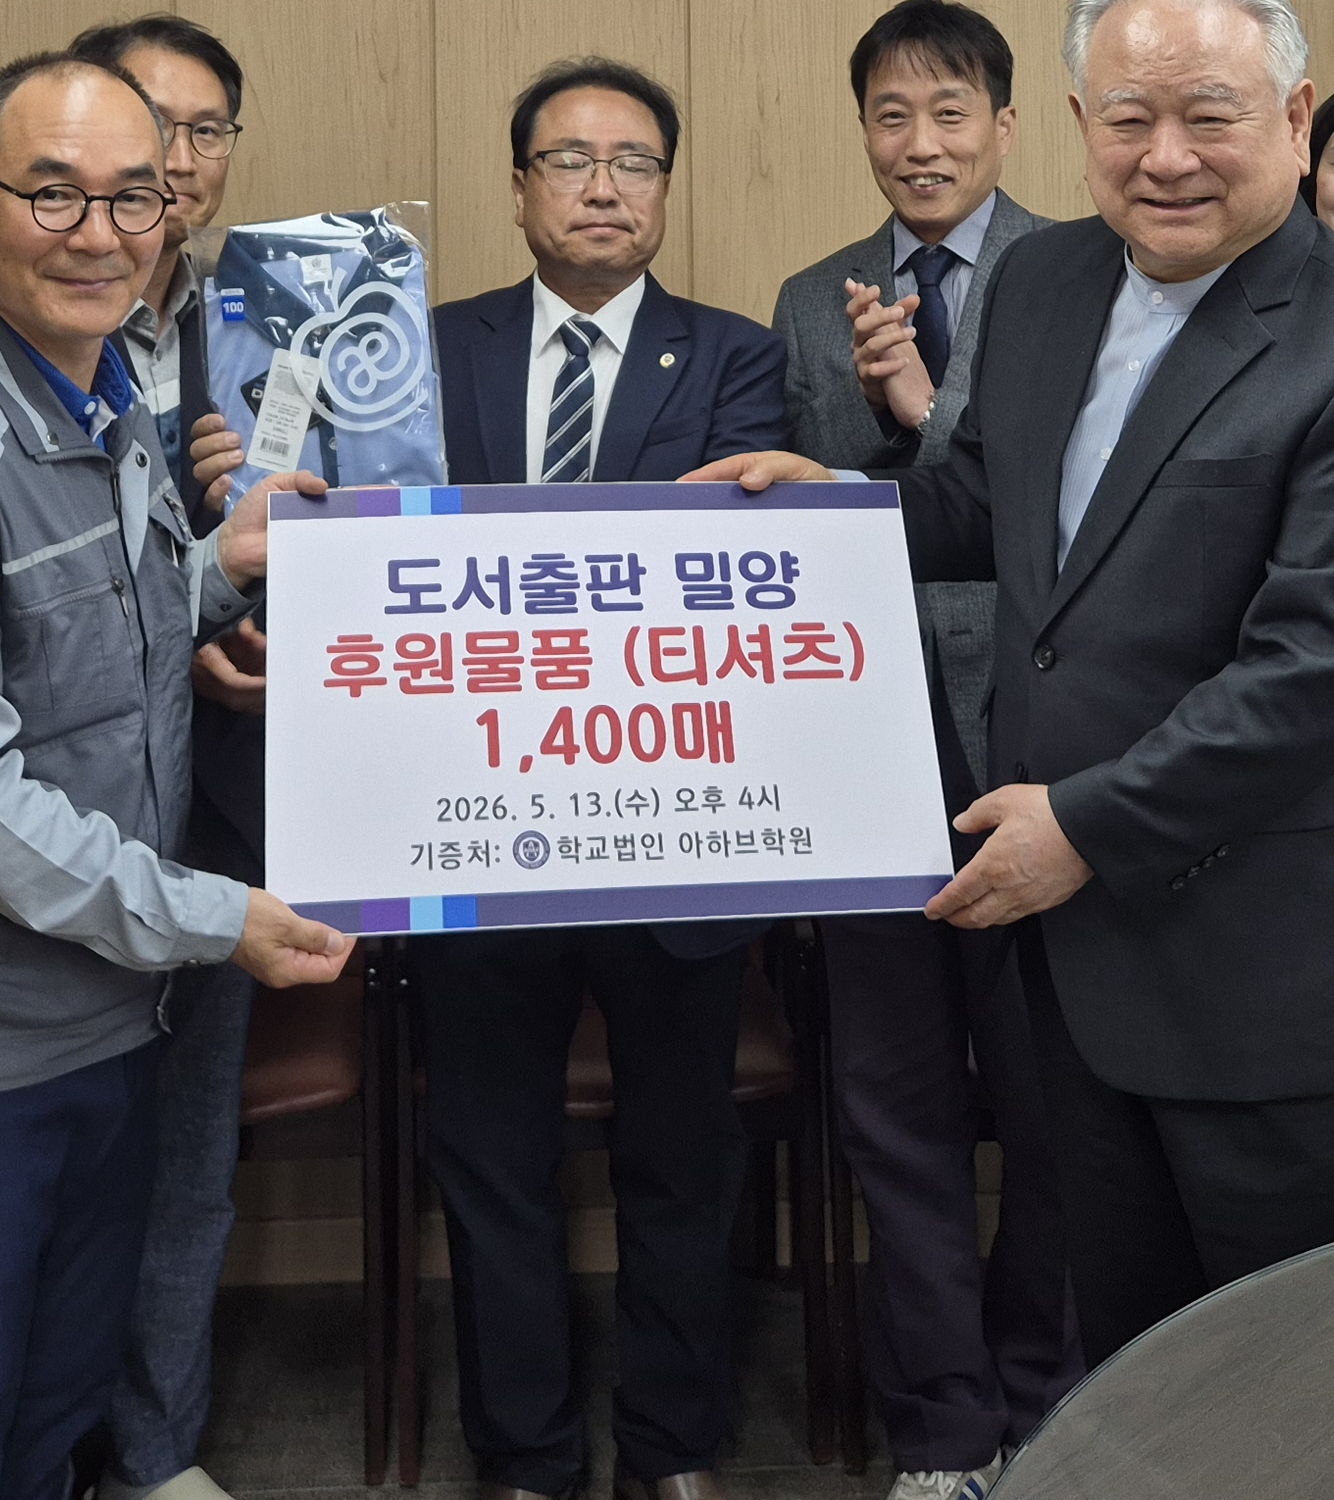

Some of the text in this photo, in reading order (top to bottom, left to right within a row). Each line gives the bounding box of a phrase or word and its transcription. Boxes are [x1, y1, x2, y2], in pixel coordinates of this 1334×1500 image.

[222, 301, 244, 314] 100
[383, 549, 801, 617] 도서출판 밀양
[322, 620, 866, 699] 후원물품 (티셔츠)
[474, 699, 736, 775] 1,400매
[435, 782, 783, 823] 2026. 5. 13.(수) 오후 4시
[409, 837, 501, 871] 기증처:
[556, 831, 666, 864] 학교법인
[678, 825, 814, 860] 아하브학원
